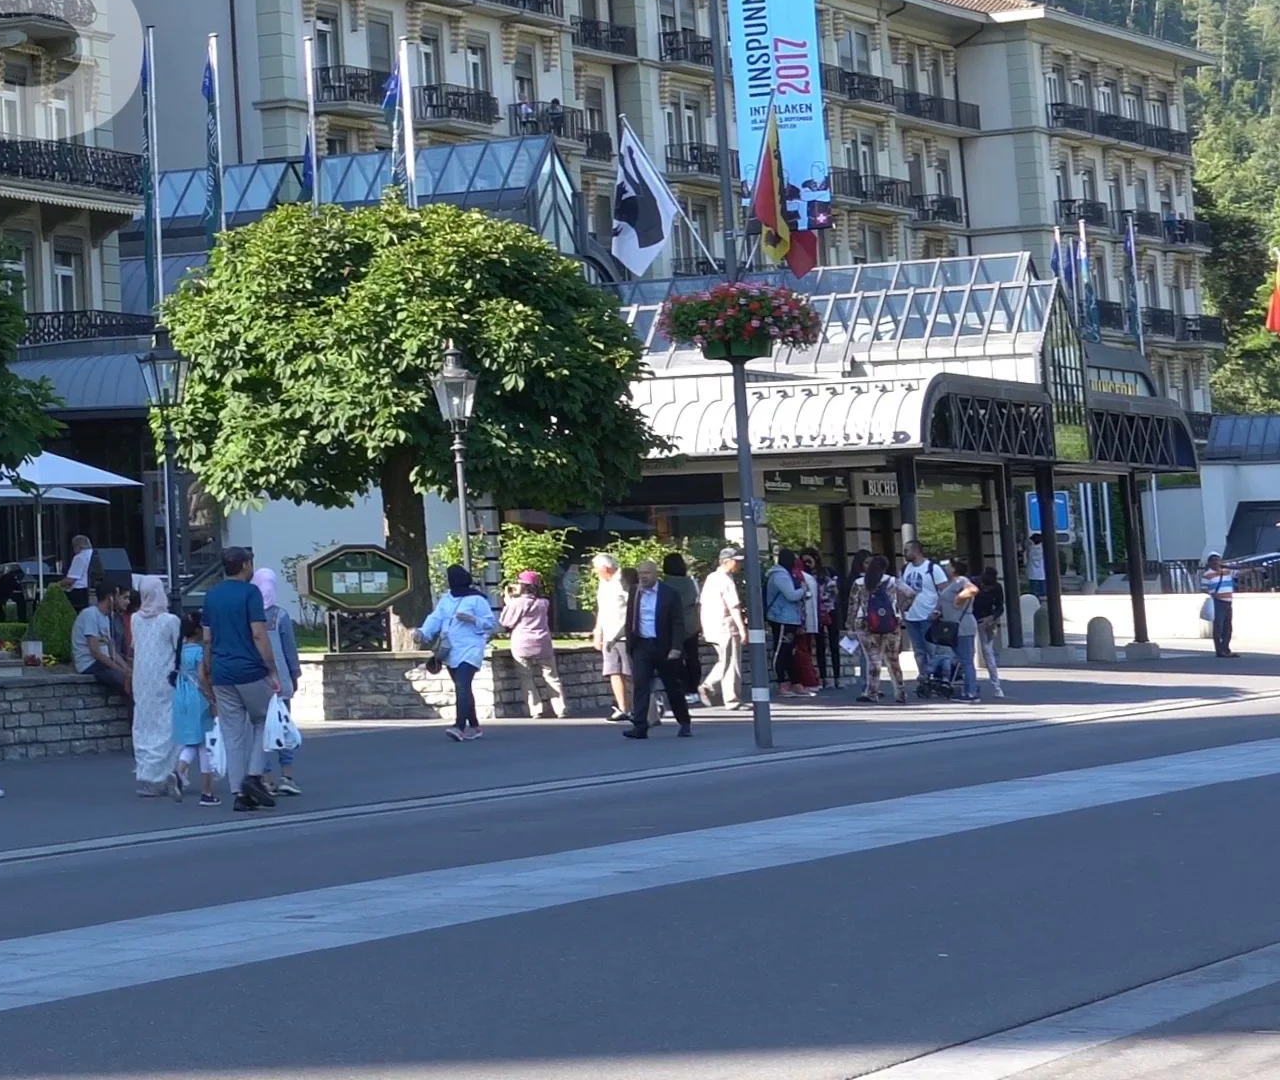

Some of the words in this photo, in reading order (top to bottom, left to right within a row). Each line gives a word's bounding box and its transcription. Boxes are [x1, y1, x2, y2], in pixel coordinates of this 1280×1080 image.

[773, 37, 811, 96] 2017
[749, 103, 813, 117] INTRLAKEN
[868, 479, 899, 497] BUCHE
